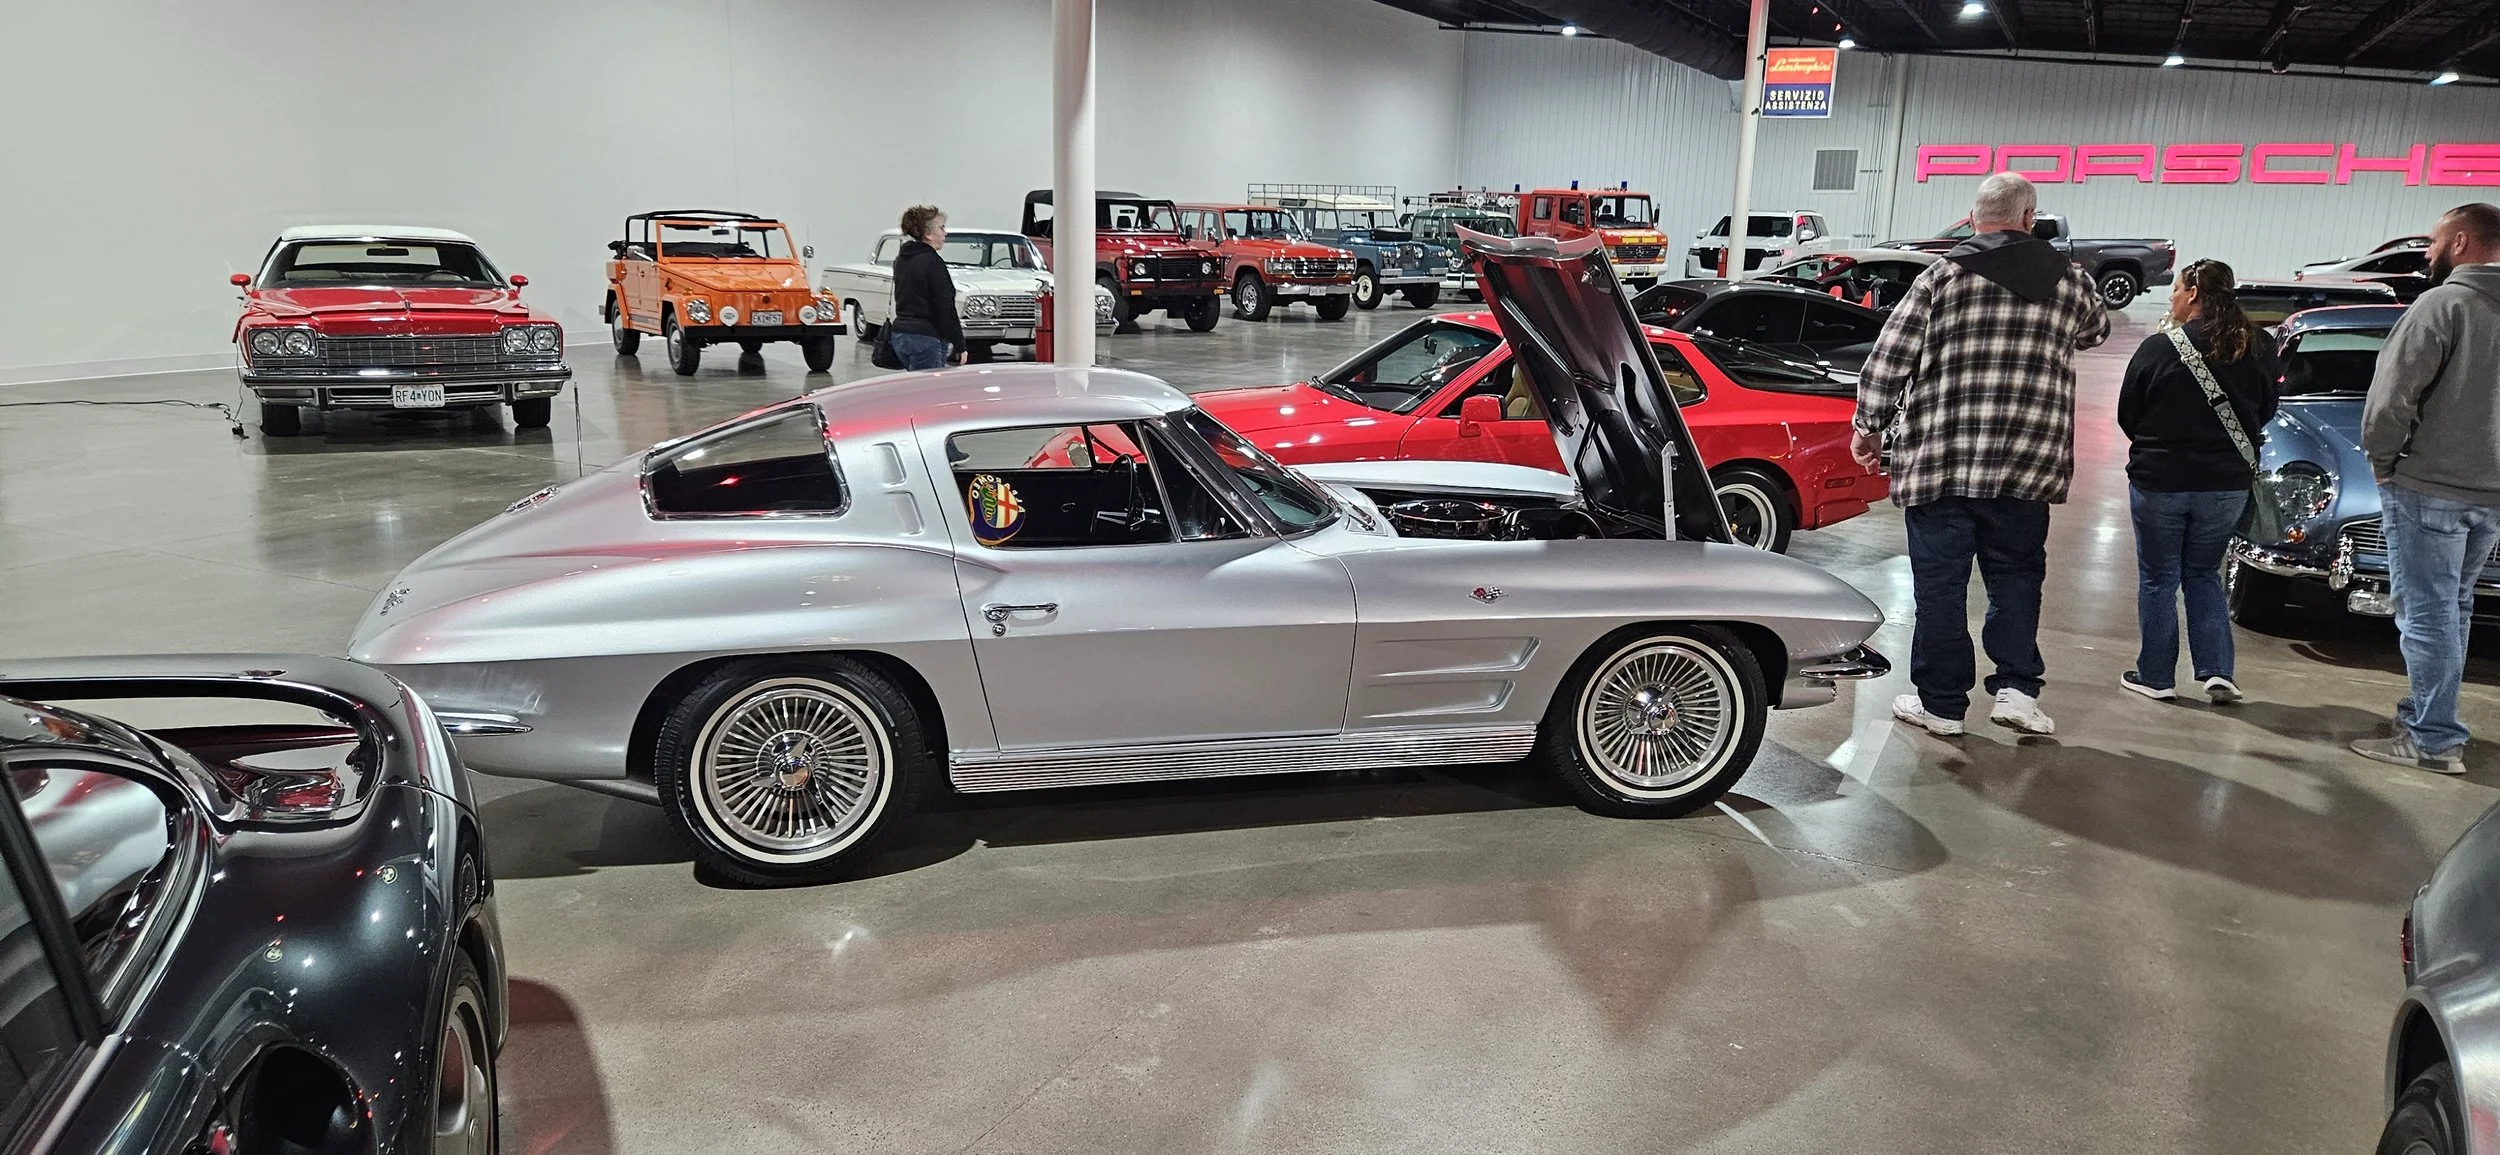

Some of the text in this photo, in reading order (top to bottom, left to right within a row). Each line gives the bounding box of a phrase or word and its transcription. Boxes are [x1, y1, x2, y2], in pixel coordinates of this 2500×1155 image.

[1769, 58, 1832, 74] Lamborghini
[1770, 90, 1824, 101] SERVIZIO
[1765, 101, 1827, 110] ASSISTENZA
[1917, 143, 2500, 187] PORSCHE
